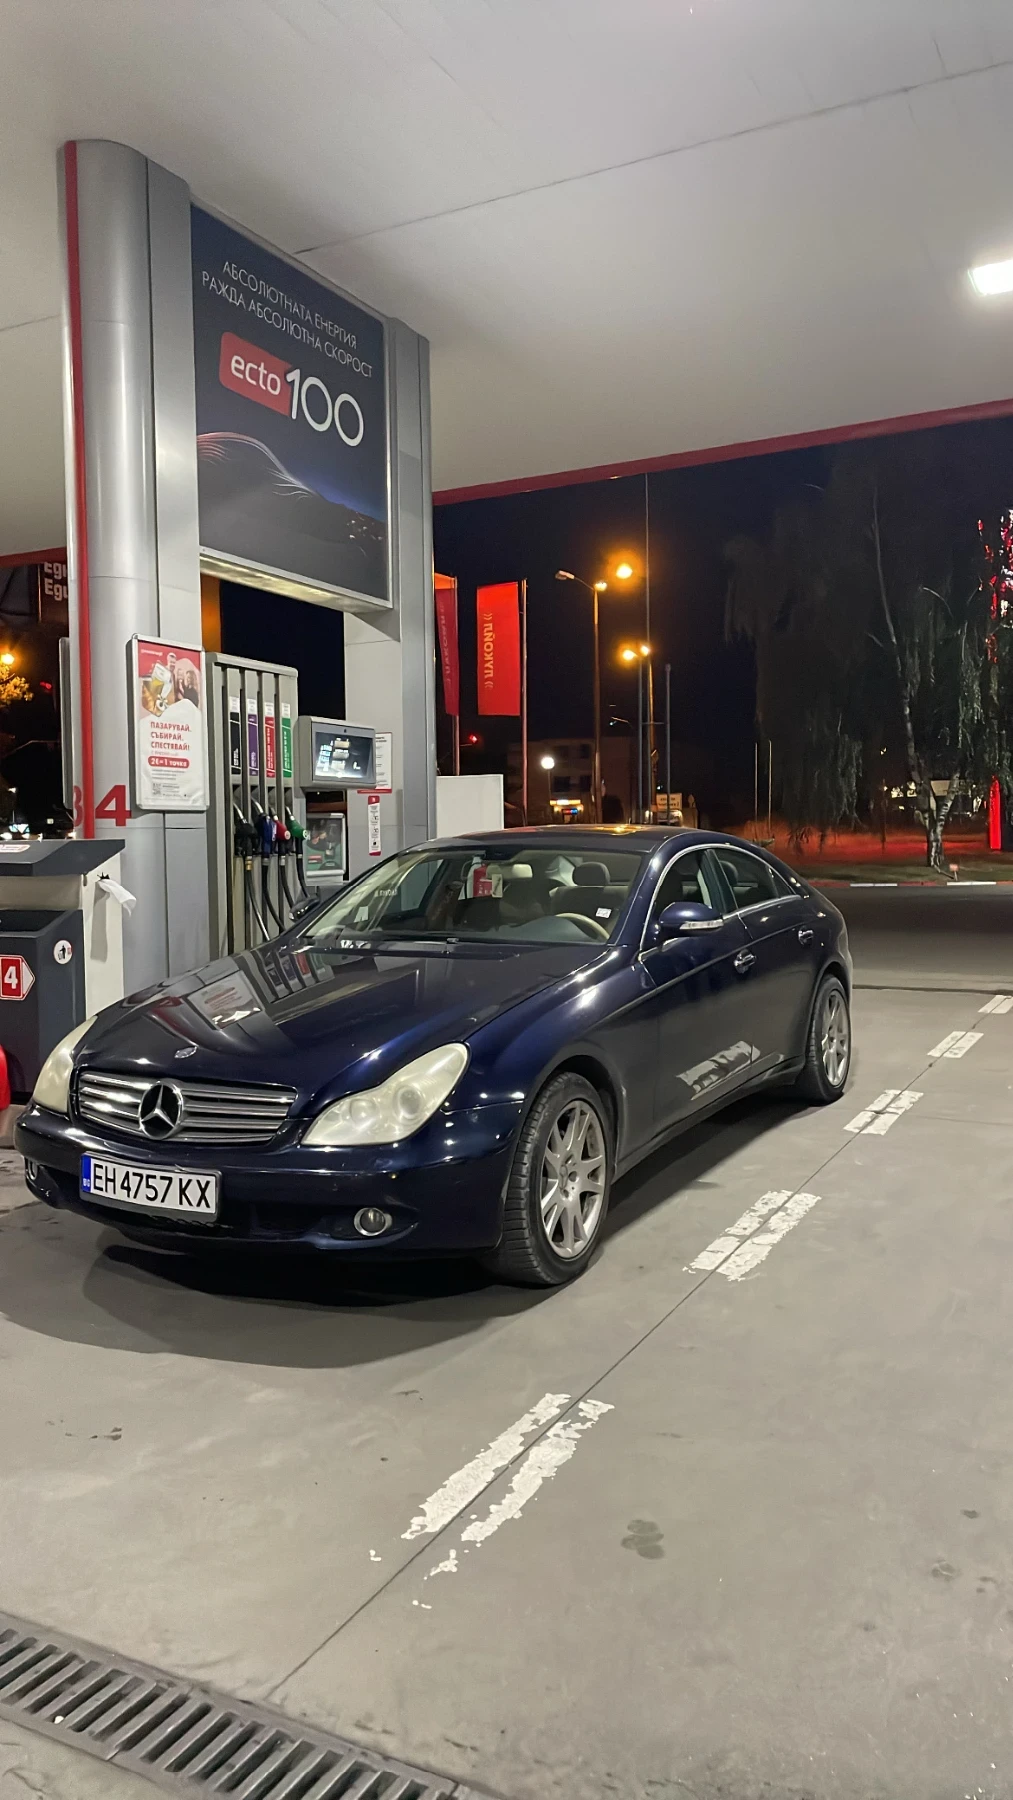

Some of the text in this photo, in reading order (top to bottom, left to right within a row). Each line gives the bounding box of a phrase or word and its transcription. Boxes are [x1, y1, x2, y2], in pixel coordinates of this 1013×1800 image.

[202, 271, 372, 377] РАЖДА АБСОЛЮТНА СКОРОСТ
[223, 261, 357, 349] АБСОЛЮТНАТА ЕНЕРГИЯ
[231, 355, 365, 447] ecto 100
[150, 741, 190, 751] СПЕСТЯВАЙ!
[95, 784, 132, 827] 4
[4, 965, 19, 989] 4
